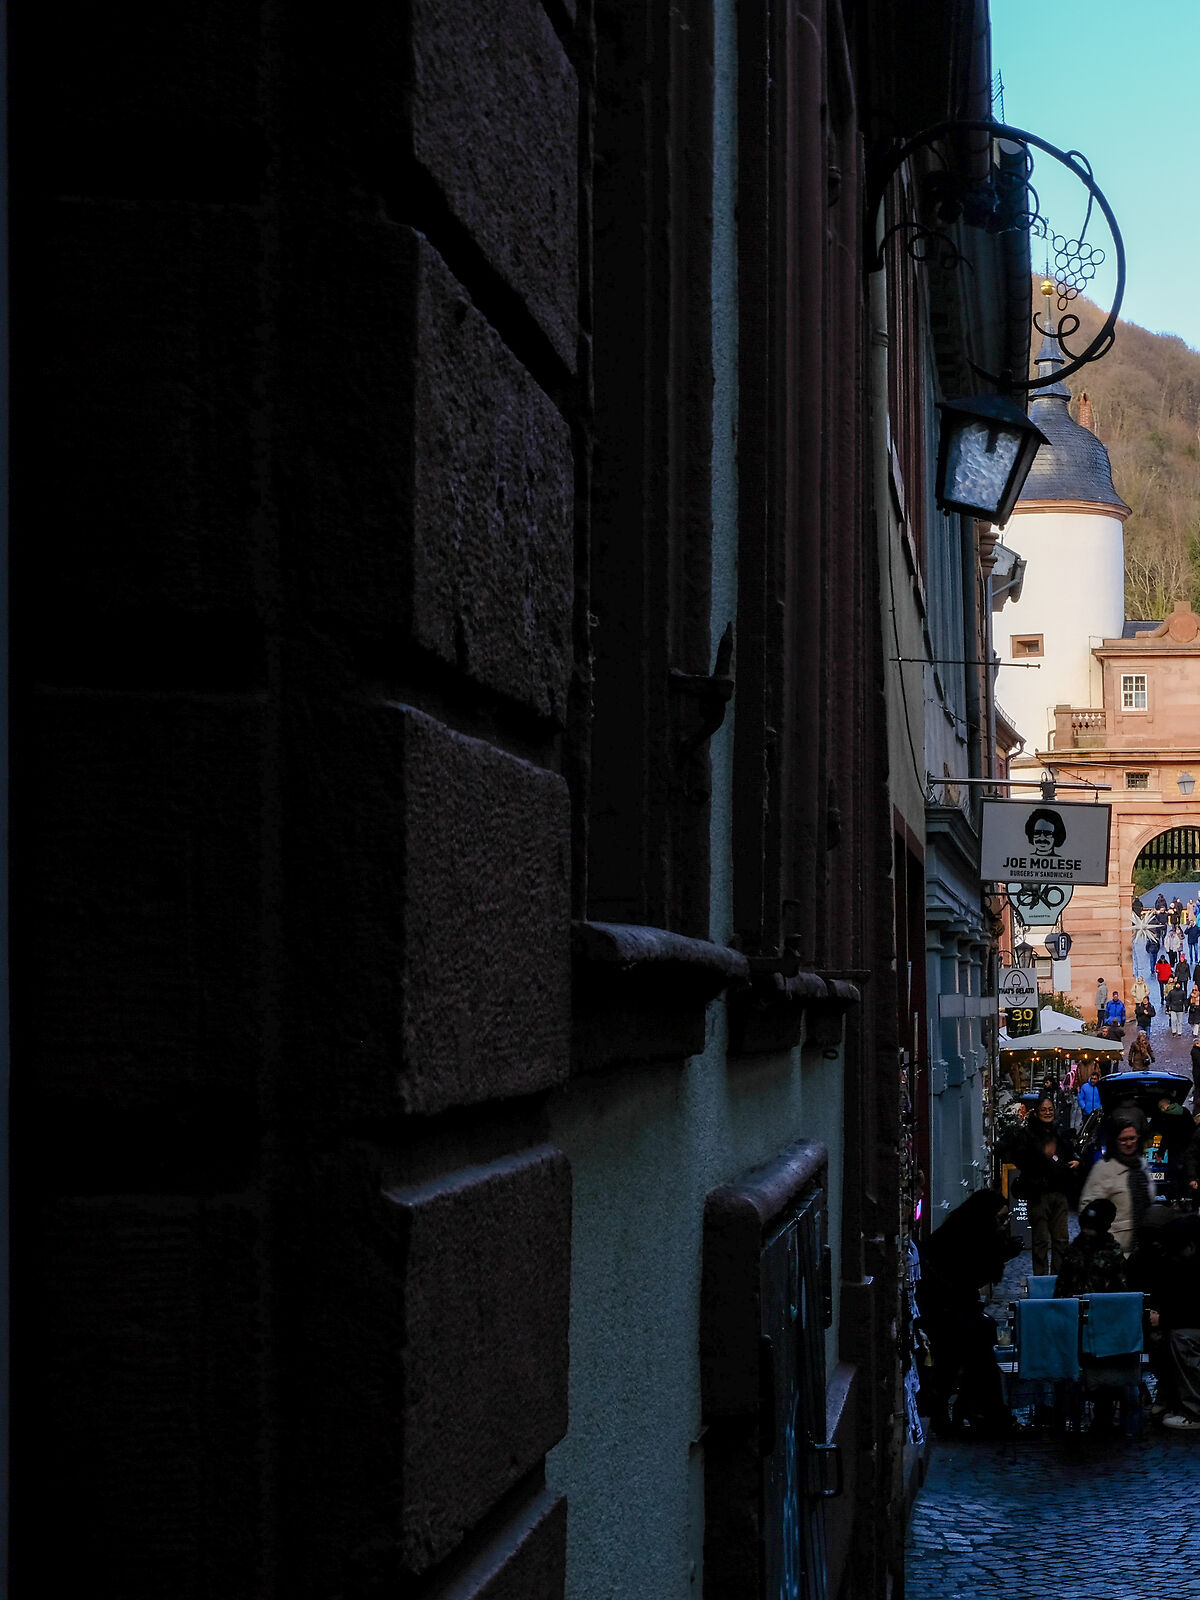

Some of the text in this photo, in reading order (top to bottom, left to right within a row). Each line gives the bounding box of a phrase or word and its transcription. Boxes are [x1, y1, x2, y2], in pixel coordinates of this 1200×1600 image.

[1003, 857, 1082, 871] JOE MOLESE
[999, 987, 1035, 995] THAT'S GELATO
[1012, 1009, 1034, 1021] 30
